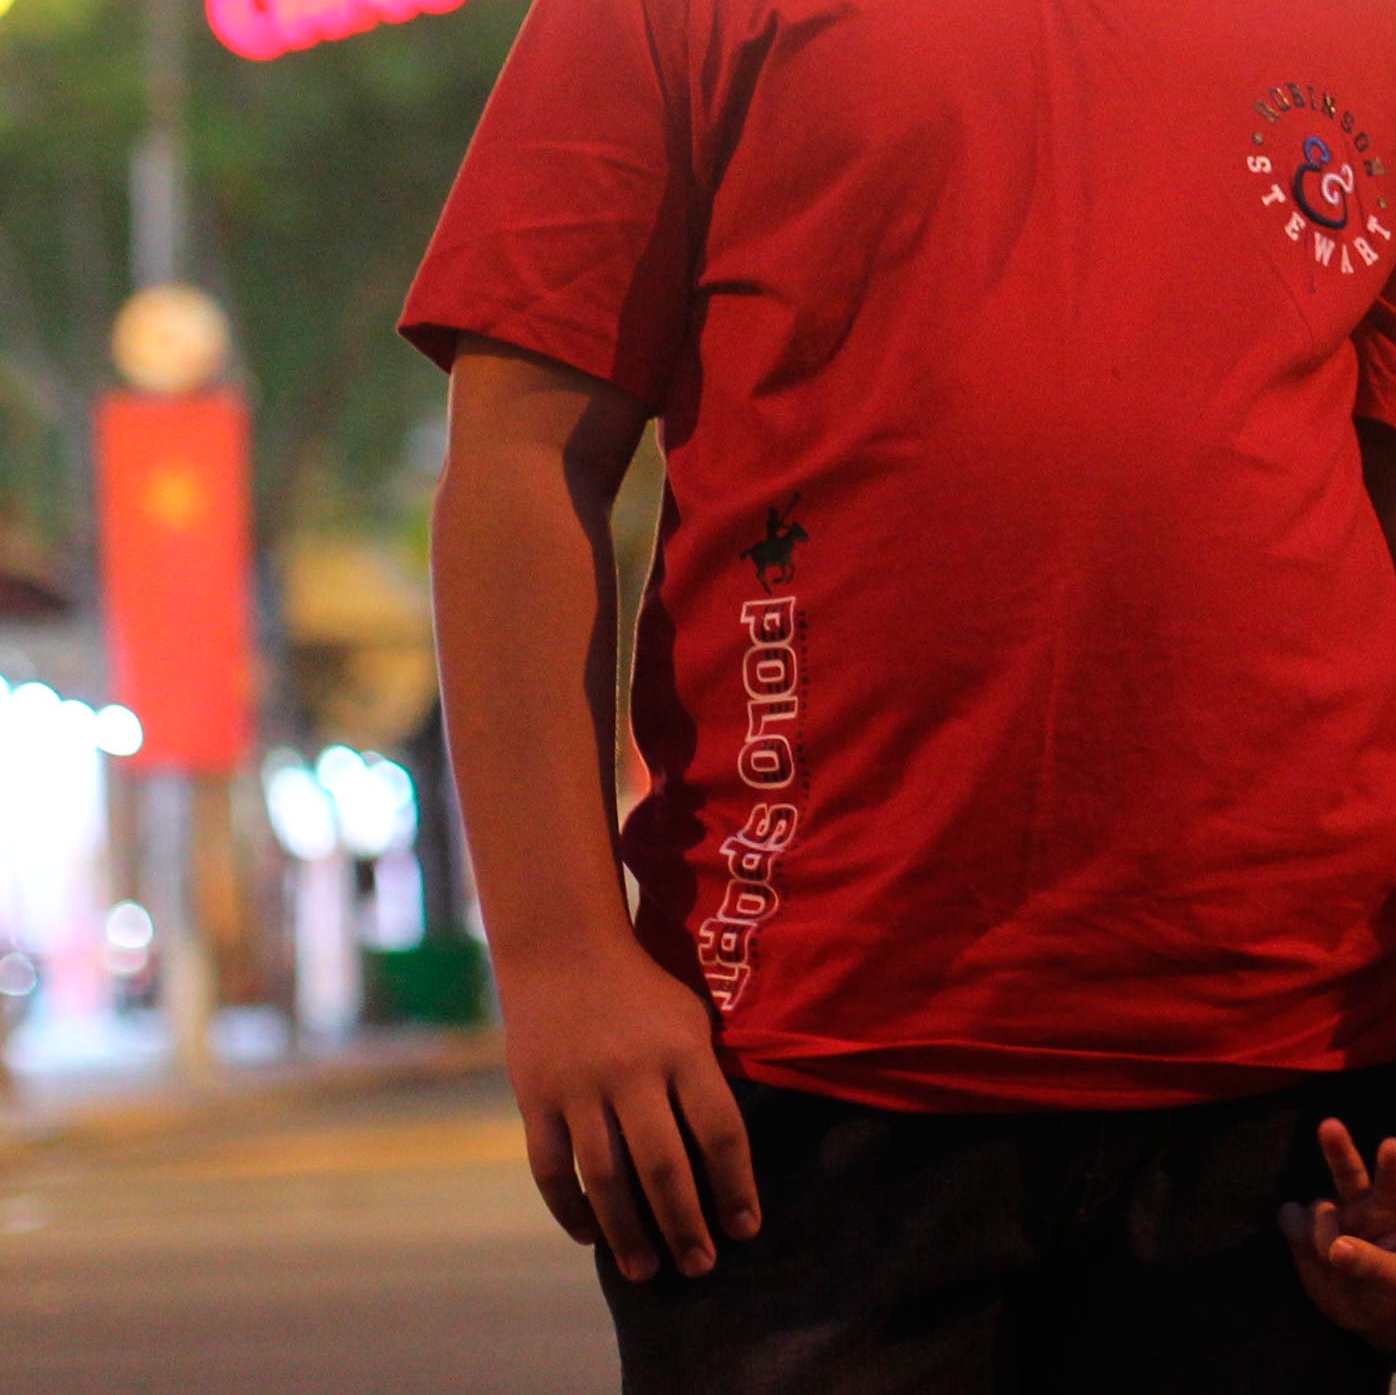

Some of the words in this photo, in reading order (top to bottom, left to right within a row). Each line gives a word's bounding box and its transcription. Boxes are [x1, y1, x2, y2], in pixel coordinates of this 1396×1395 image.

[1253, 82, 1388, 178] ROBINSON
[1247, 155, 1392, 274] STEWART
[736, 596, 799, 790] POLO
[698, 803, 799, 1012] SPORT
